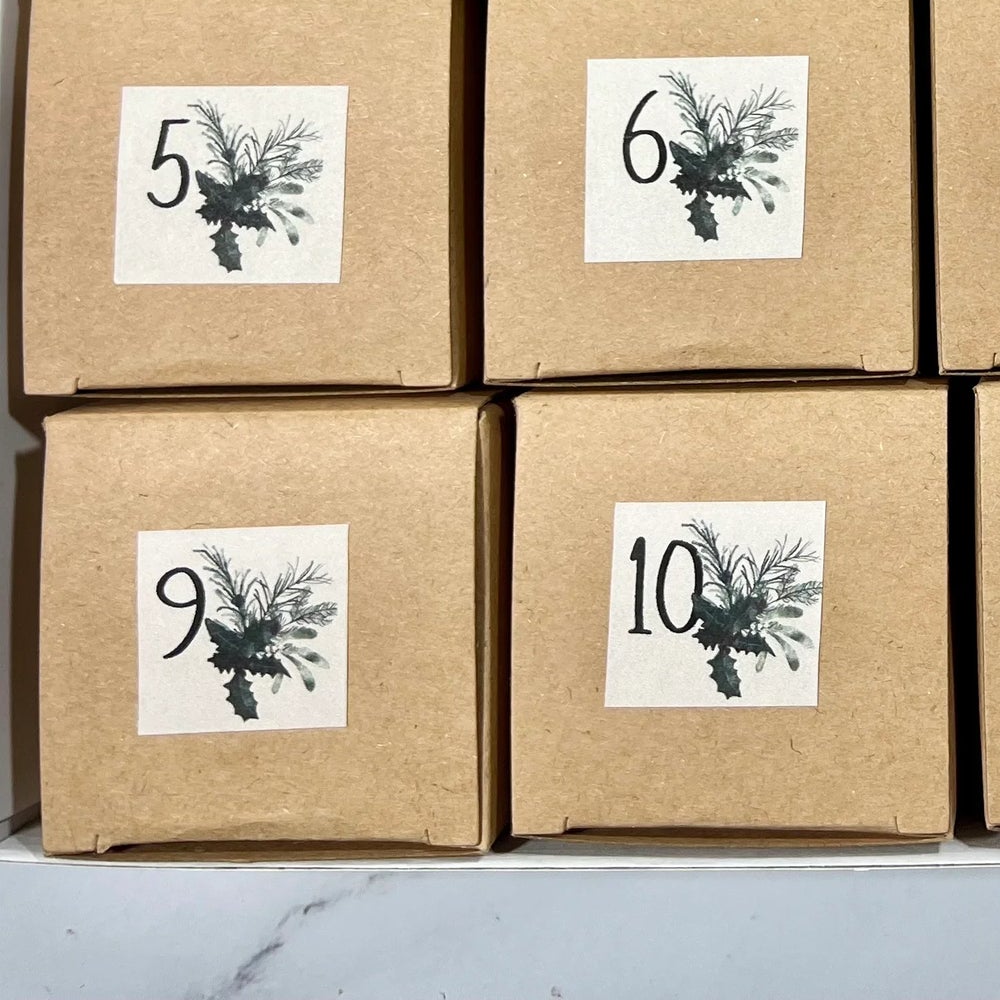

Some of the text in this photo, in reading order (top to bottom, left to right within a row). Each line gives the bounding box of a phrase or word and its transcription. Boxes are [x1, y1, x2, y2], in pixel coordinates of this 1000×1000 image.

[146, 119, 190, 208] 5
[622, 90, 667, 184] 6
[156, 566, 206, 659] 9
[628, 536, 703, 635] 10
